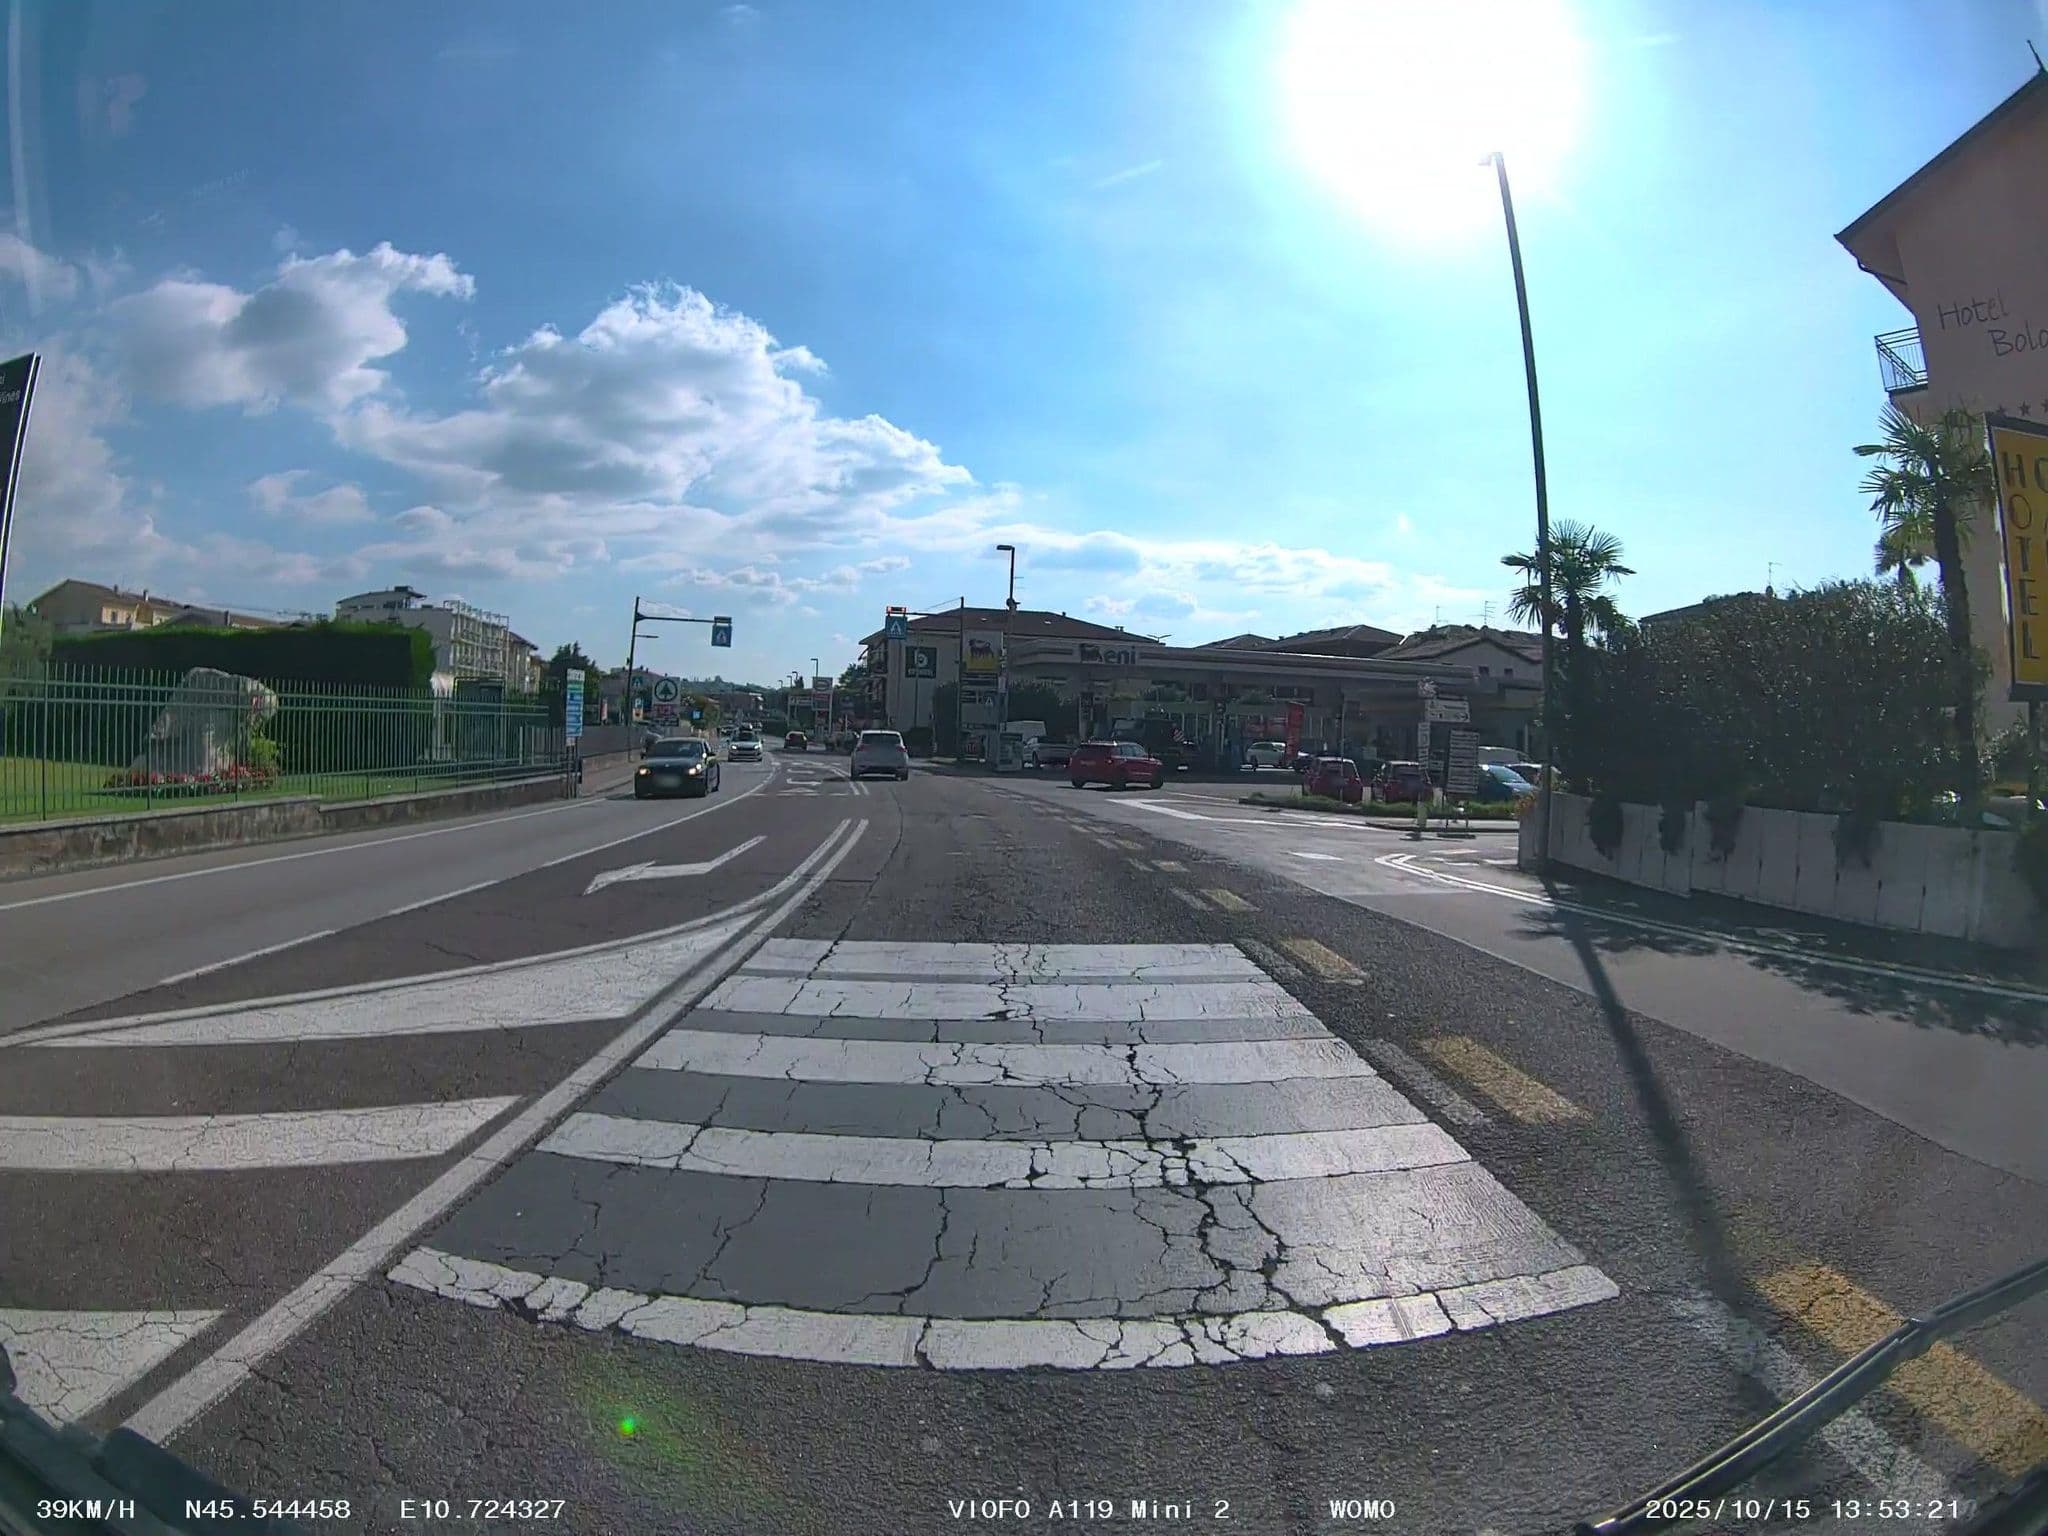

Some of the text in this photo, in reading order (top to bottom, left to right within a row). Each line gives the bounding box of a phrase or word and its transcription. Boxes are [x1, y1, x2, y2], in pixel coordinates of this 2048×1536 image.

[1937, 287, 2009, 330] Hotel
[2001, 450, 2041, 660] HOTEL
[1104, 645, 1136, 665] eni
